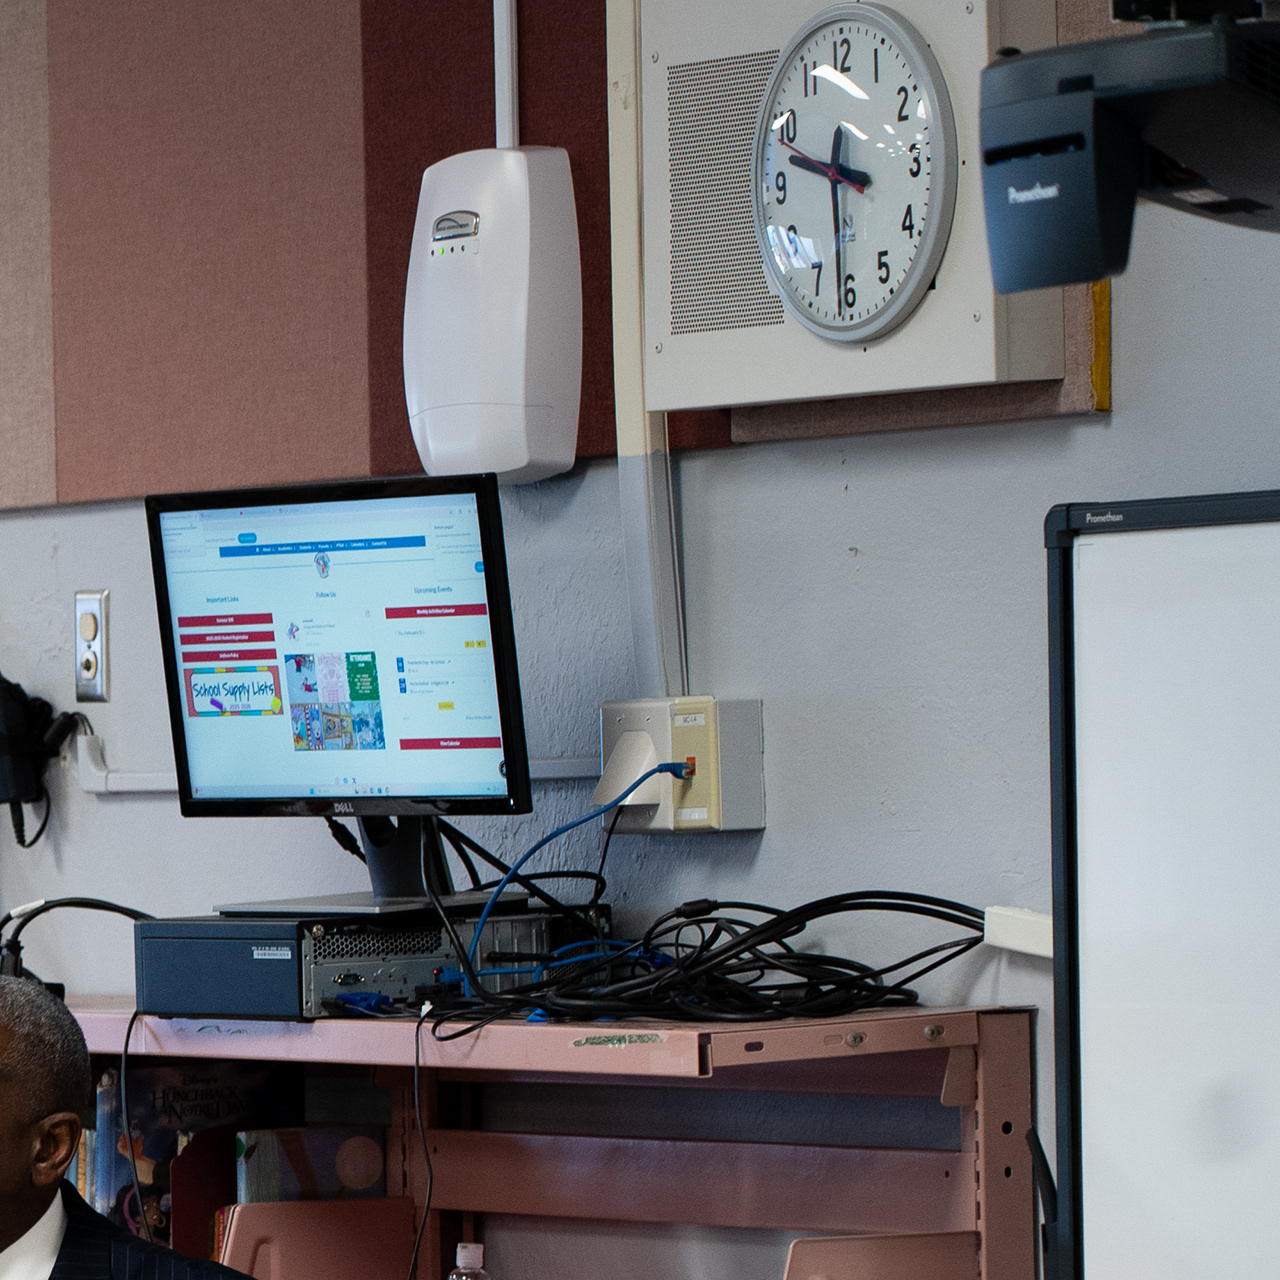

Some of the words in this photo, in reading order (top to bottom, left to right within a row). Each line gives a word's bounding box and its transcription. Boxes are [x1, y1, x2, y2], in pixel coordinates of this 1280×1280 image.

[833, 38, 853, 75] 12
[897, 86, 910, 122] 2
[778, 108, 798, 145] 10
[908, 143, 922, 178] 3
[775, 171, 788, 205] 9
[901, 204, 915, 238] 4
[811, 262, 824, 297] 7
[877, 250, 890, 284] 5
[844, 274, 857, 308] 6
[1085, 511, 1123, 523] Promethean
[193, 682, 221, 698] School
[222, 683, 250, 702] Supply
[252, 681, 274, 696] Lists
